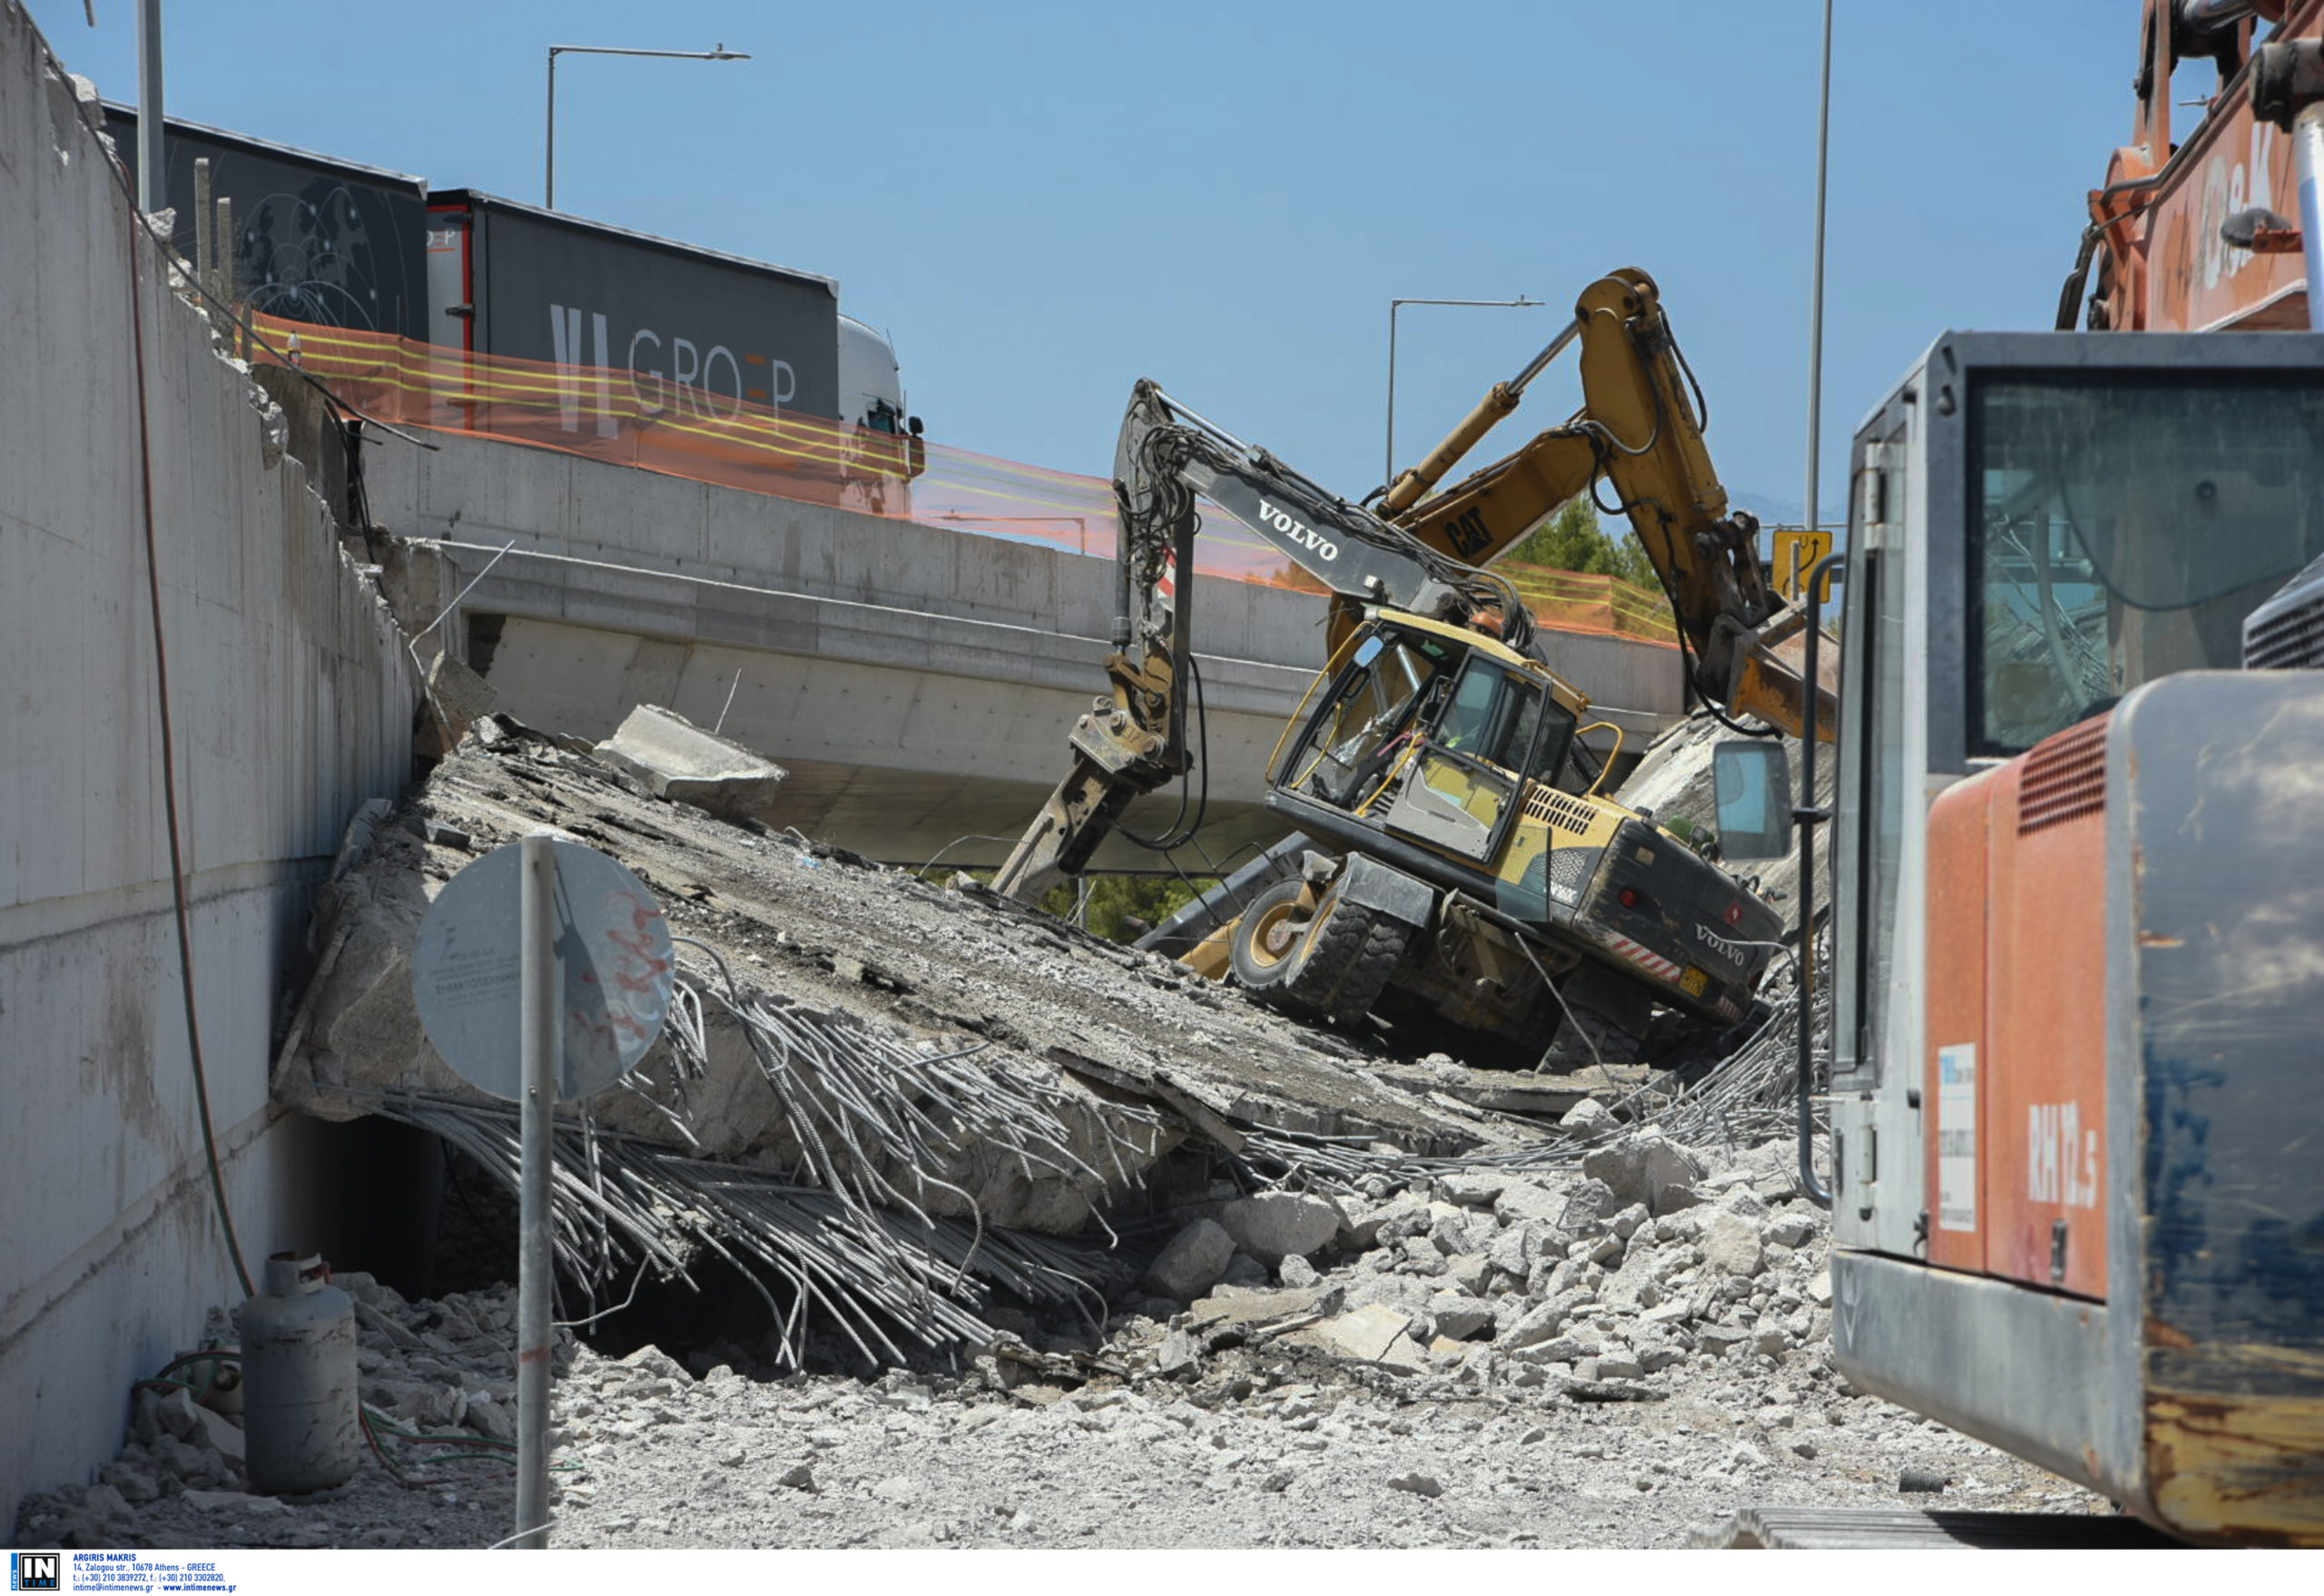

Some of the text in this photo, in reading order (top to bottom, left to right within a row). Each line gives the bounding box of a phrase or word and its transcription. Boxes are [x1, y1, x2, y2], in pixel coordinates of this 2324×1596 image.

[1258, 499, 1339, 562] VOLVO
[1445, 506, 1494, 559] CAT
[1695, 922, 1745, 967] VOLVO
